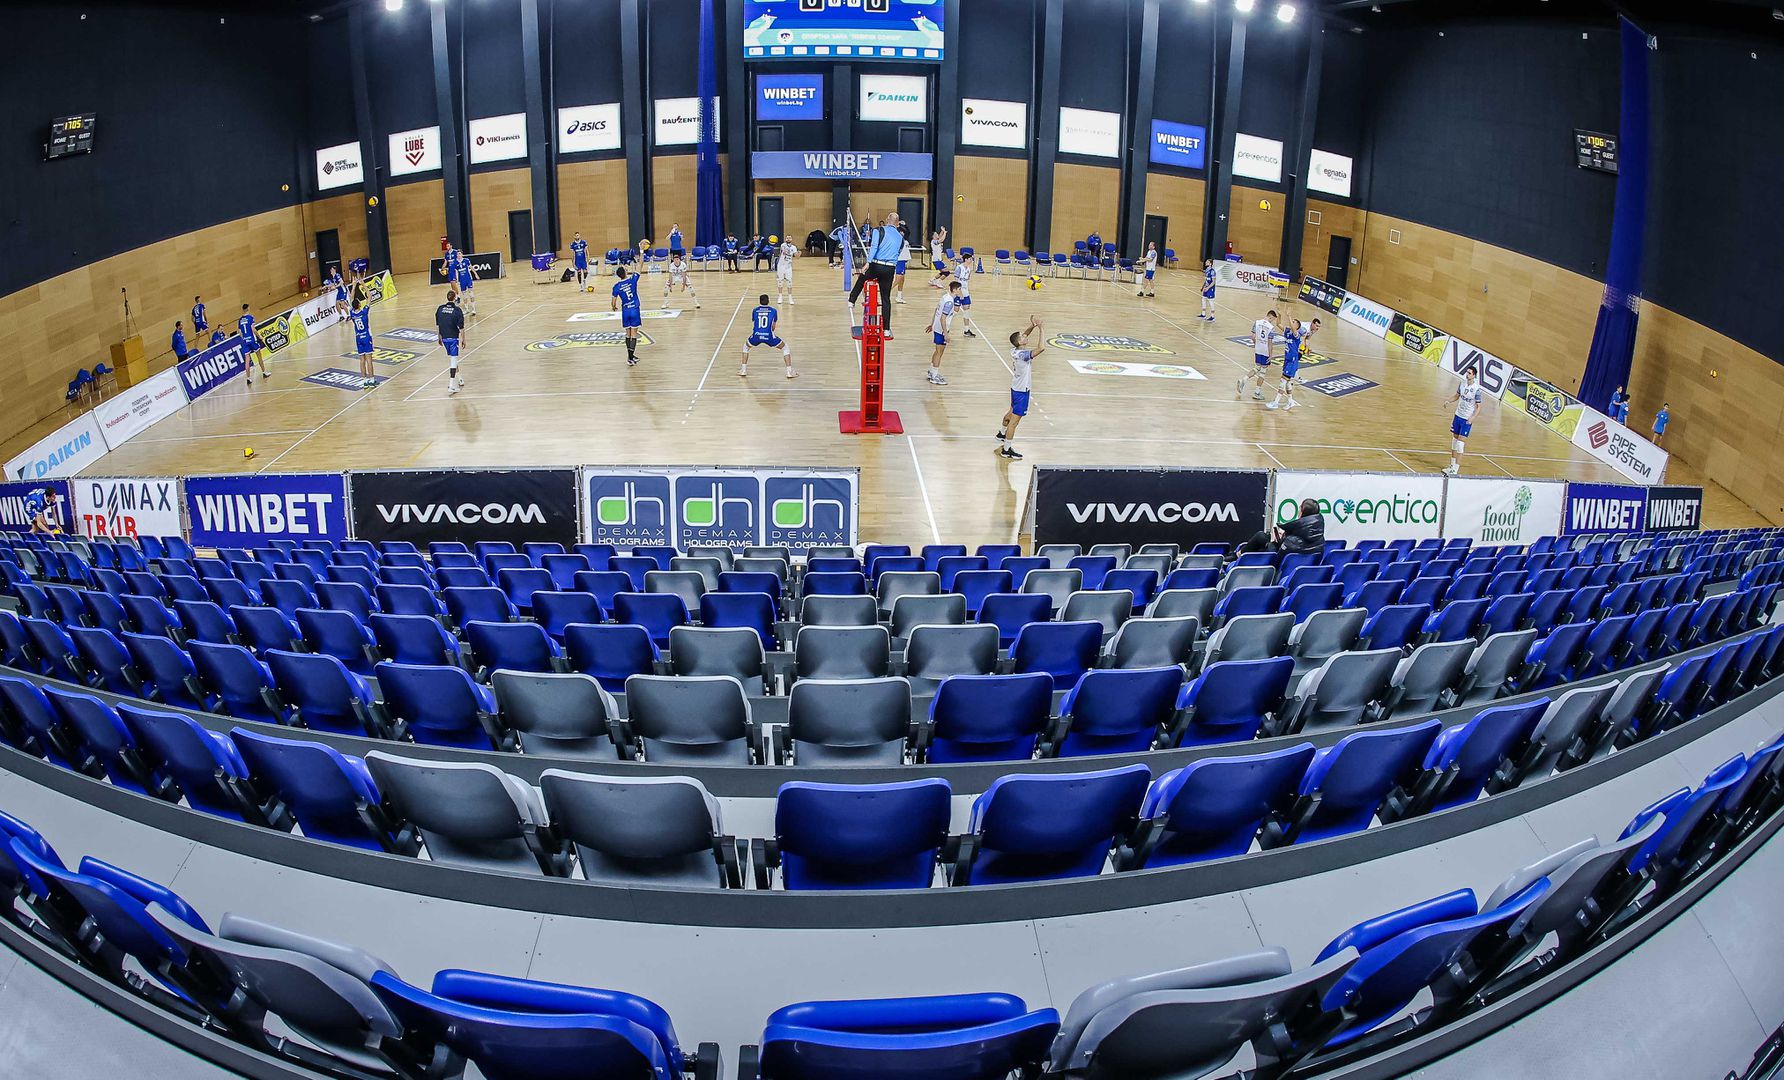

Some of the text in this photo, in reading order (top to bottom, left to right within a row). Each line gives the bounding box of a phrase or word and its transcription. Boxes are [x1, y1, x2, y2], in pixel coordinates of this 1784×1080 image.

[763, 87, 816, 100] WINBET
[878, 94, 919, 102] DAIKIN
[776, 99, 804, 107] winbet.bg
[579, 120, 607, 132] asics
[970, 119, 1018, 128] VIVACOM
[405, 138, 425, 152] LUBE
[1156, 132, 1200, 149] WINBET
[335, 162, 359, 172] SYSTEM
[803, 153, 882, 170] WINBET
[823, 169, 861, 177] winbet.bg
[1236, 270, 1269, 284] egnati
[757, 315, 768, 329] 10
[1350, 304, 1390, 328] DAIKIN
[1260, 330, 1266, 338] 5
[184, 345, 246, 391] WINBET
[1452, 339, 1503, 394] VAS
[1313, 375, 1370, 395] WINBET
[1529, 385, 1547, 400] efbet
[1529, 396, 1548, 410] СУПЕР
[1529, 404, 1549, 419] ВОЛЕЙ
[1610, 432, 1637, 455] PIPE
[35, 431, 92, 478] DAIKIN
[1607, 443, 1652, 478] SYSTEM
[194, 493, 332, 536] WINBET
[375, 502, 547, 524] VIVACOM
[1066, 502, 1240, 523] VIVACOM
[1483, 504, 1516, 526] food
[1572, 497, 1642, 531] WINBET
[1650, 499, 1699, 529] WINBET
[598, 527, 664, 536] DEMAX
[683, 529, 752, 538] DEMAX
[771, 531, 843, 540] DEMAX
[1481, 527, 1520, 542] mood
[598, 537, 666, 546] HOLOGRAMS
[683, 539, 753, 547] HOLOGRAMS
[771, 541, 844, 549] HOLOGRAMS
